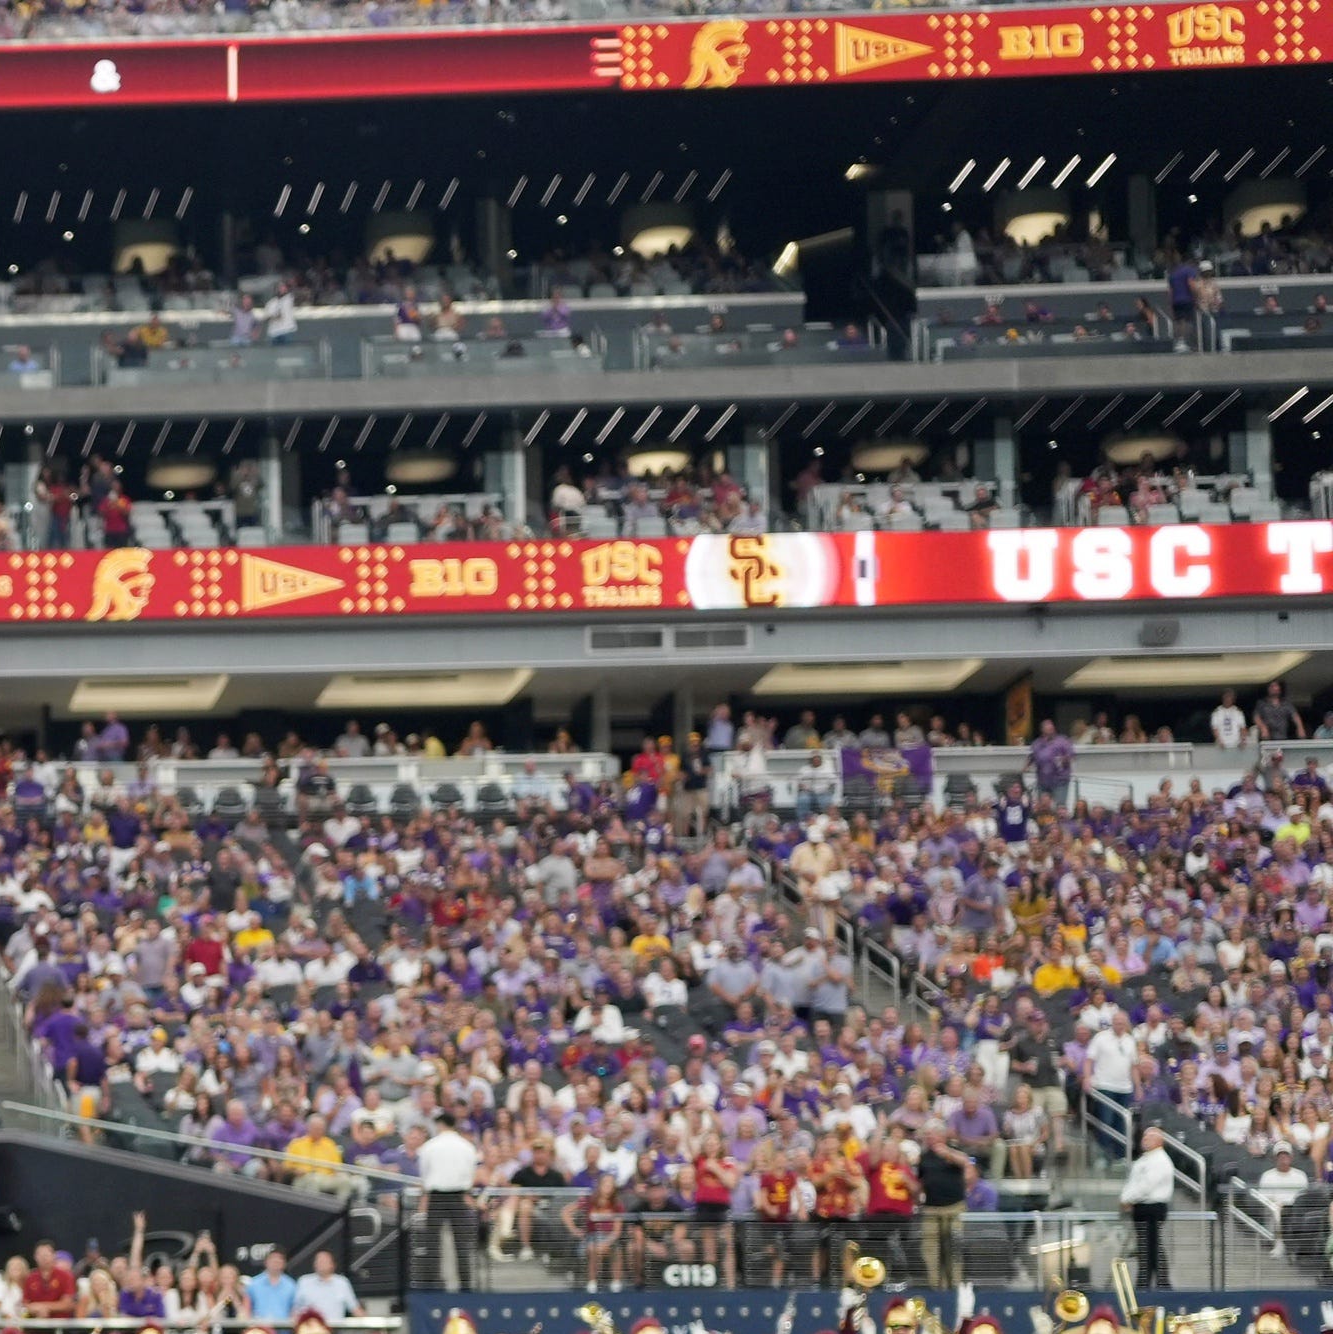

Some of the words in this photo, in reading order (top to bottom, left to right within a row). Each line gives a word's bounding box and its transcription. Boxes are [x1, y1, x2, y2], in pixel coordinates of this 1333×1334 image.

[1167, 3, 1245, 47] USC
[580, 540, 664, 586] USC
[988, 524, 1212, 602] USC
